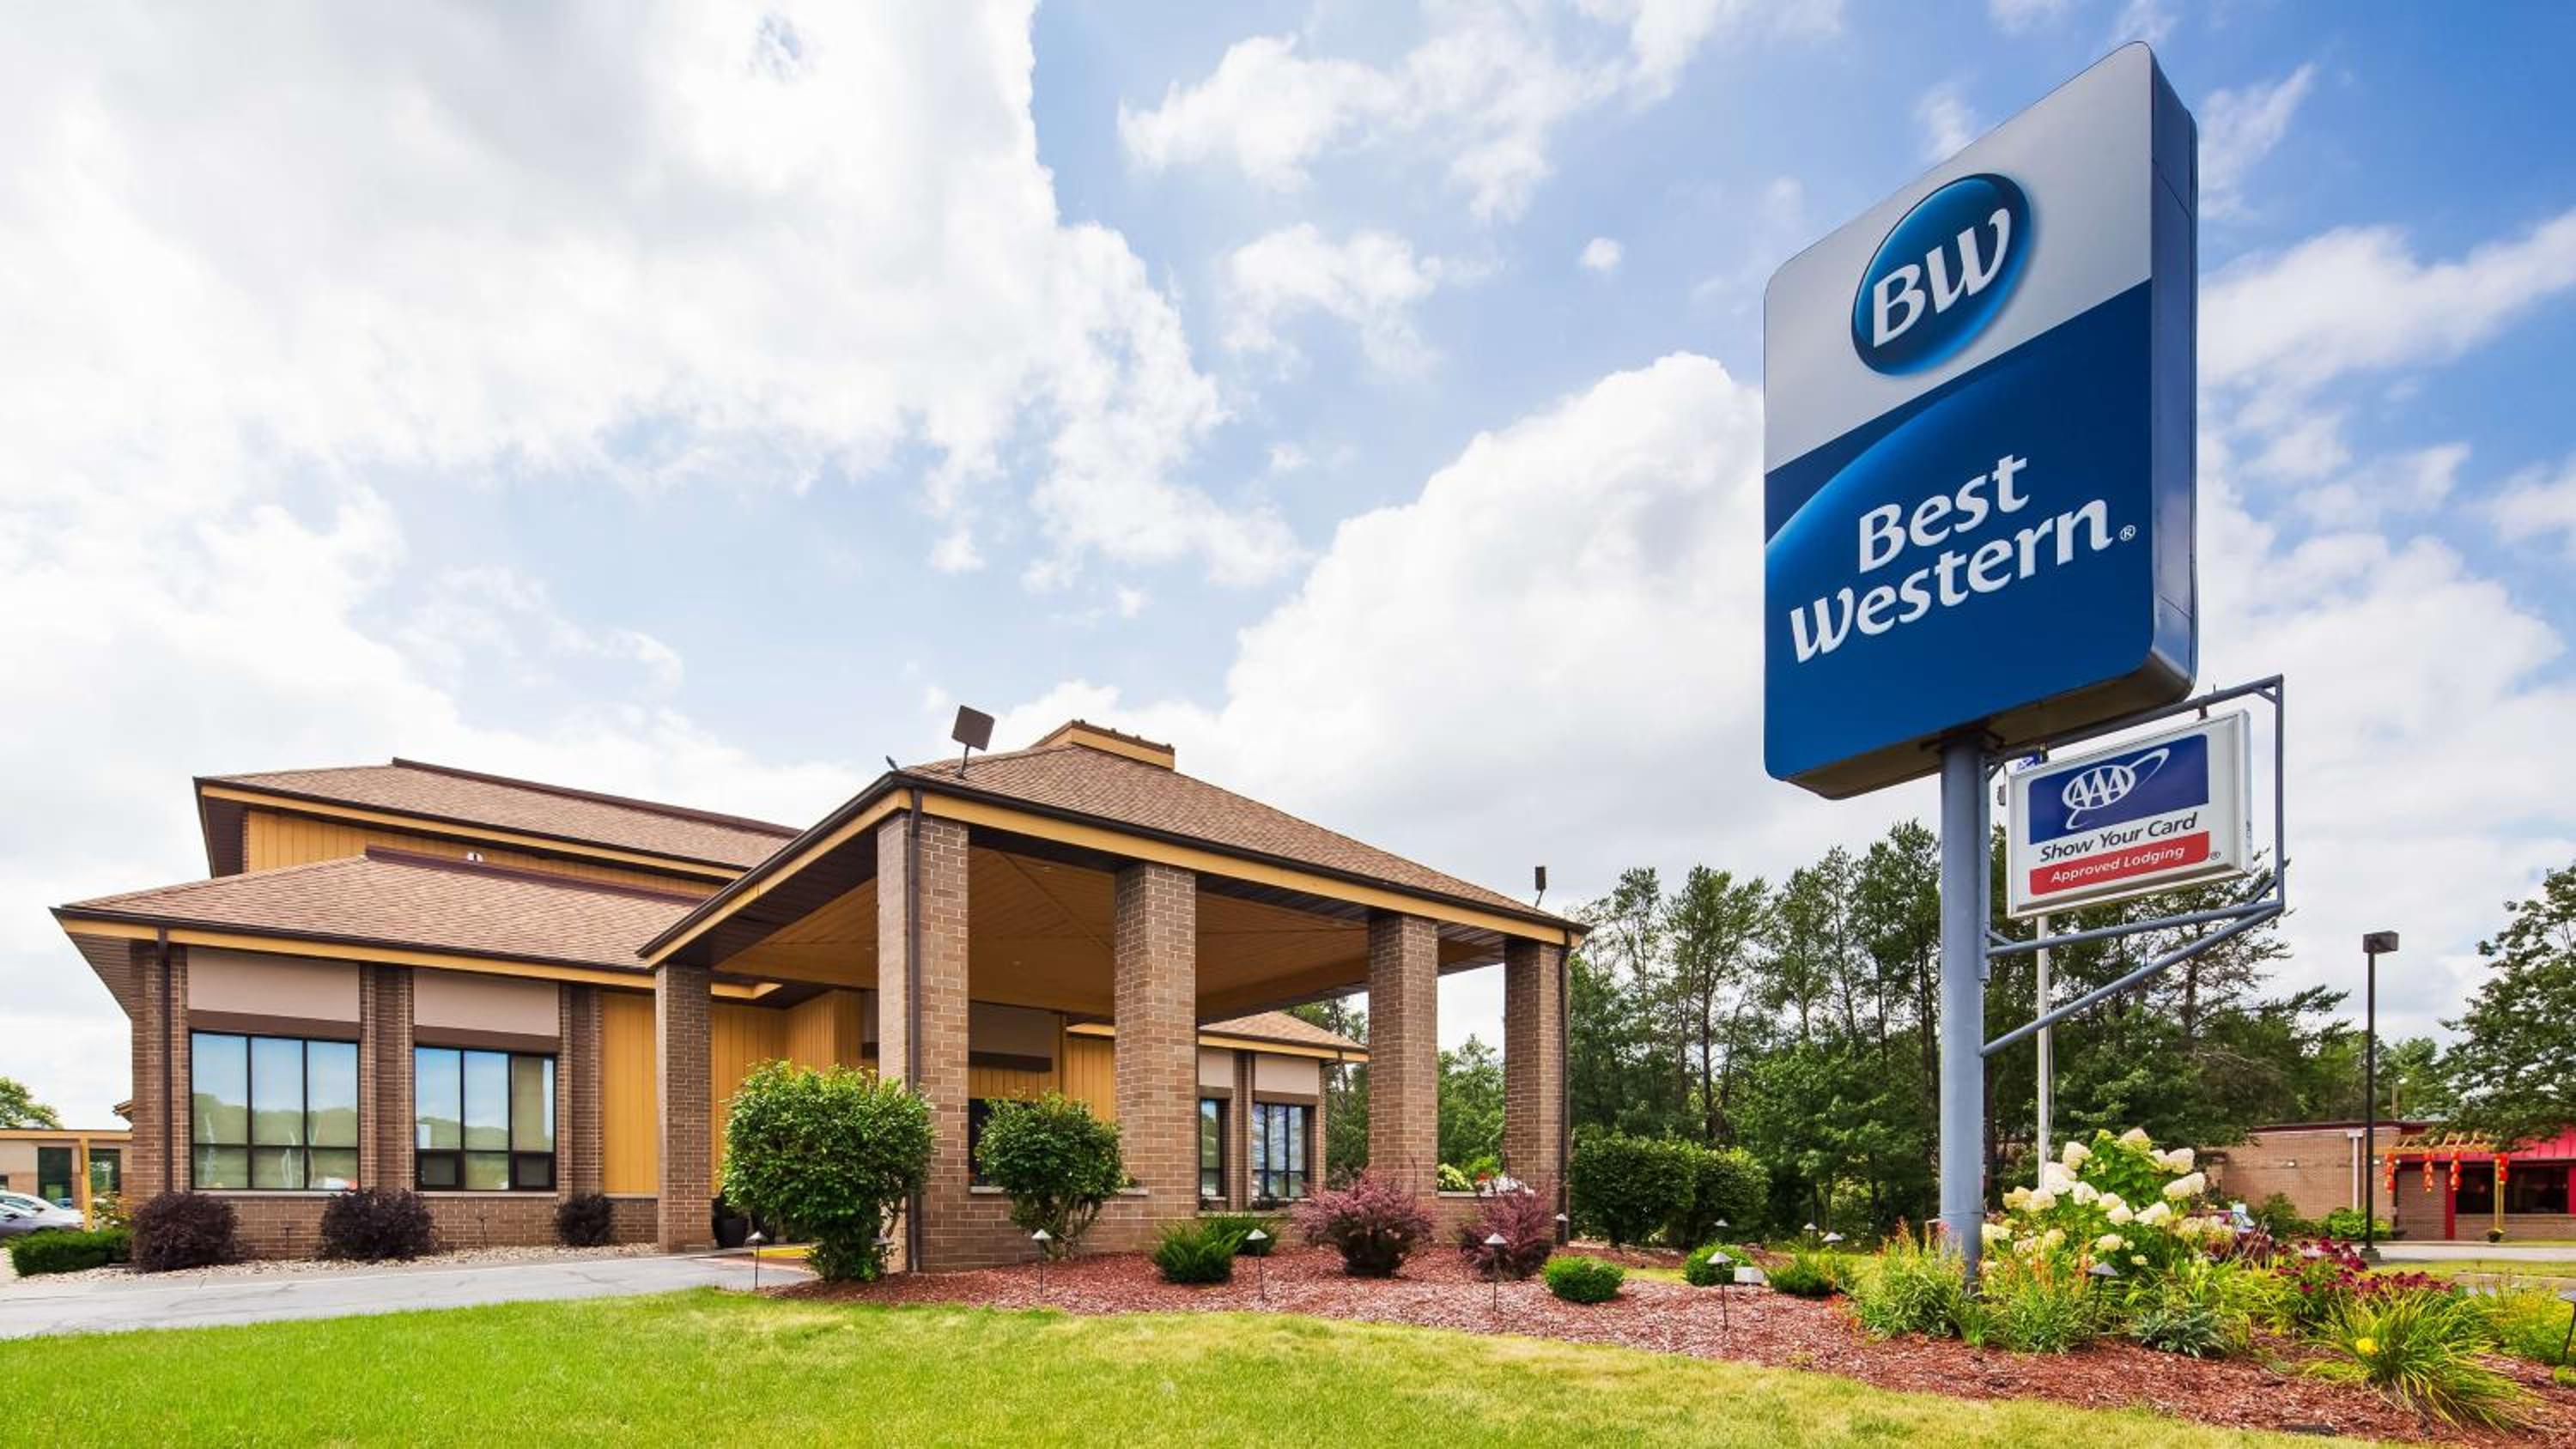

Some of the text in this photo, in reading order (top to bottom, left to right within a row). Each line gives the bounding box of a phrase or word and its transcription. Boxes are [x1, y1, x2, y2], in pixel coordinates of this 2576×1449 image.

[1873, 208, 2011, 349] BW
[1859, 454, 2029, 573] Best
[1790, 499, 2113, 663] Western
[2069, 767, 2129, 808] AAA
[2039, 811, 2198, 863] Show Your Card
[2050, 846, 2184, 883] Approved Lodging
